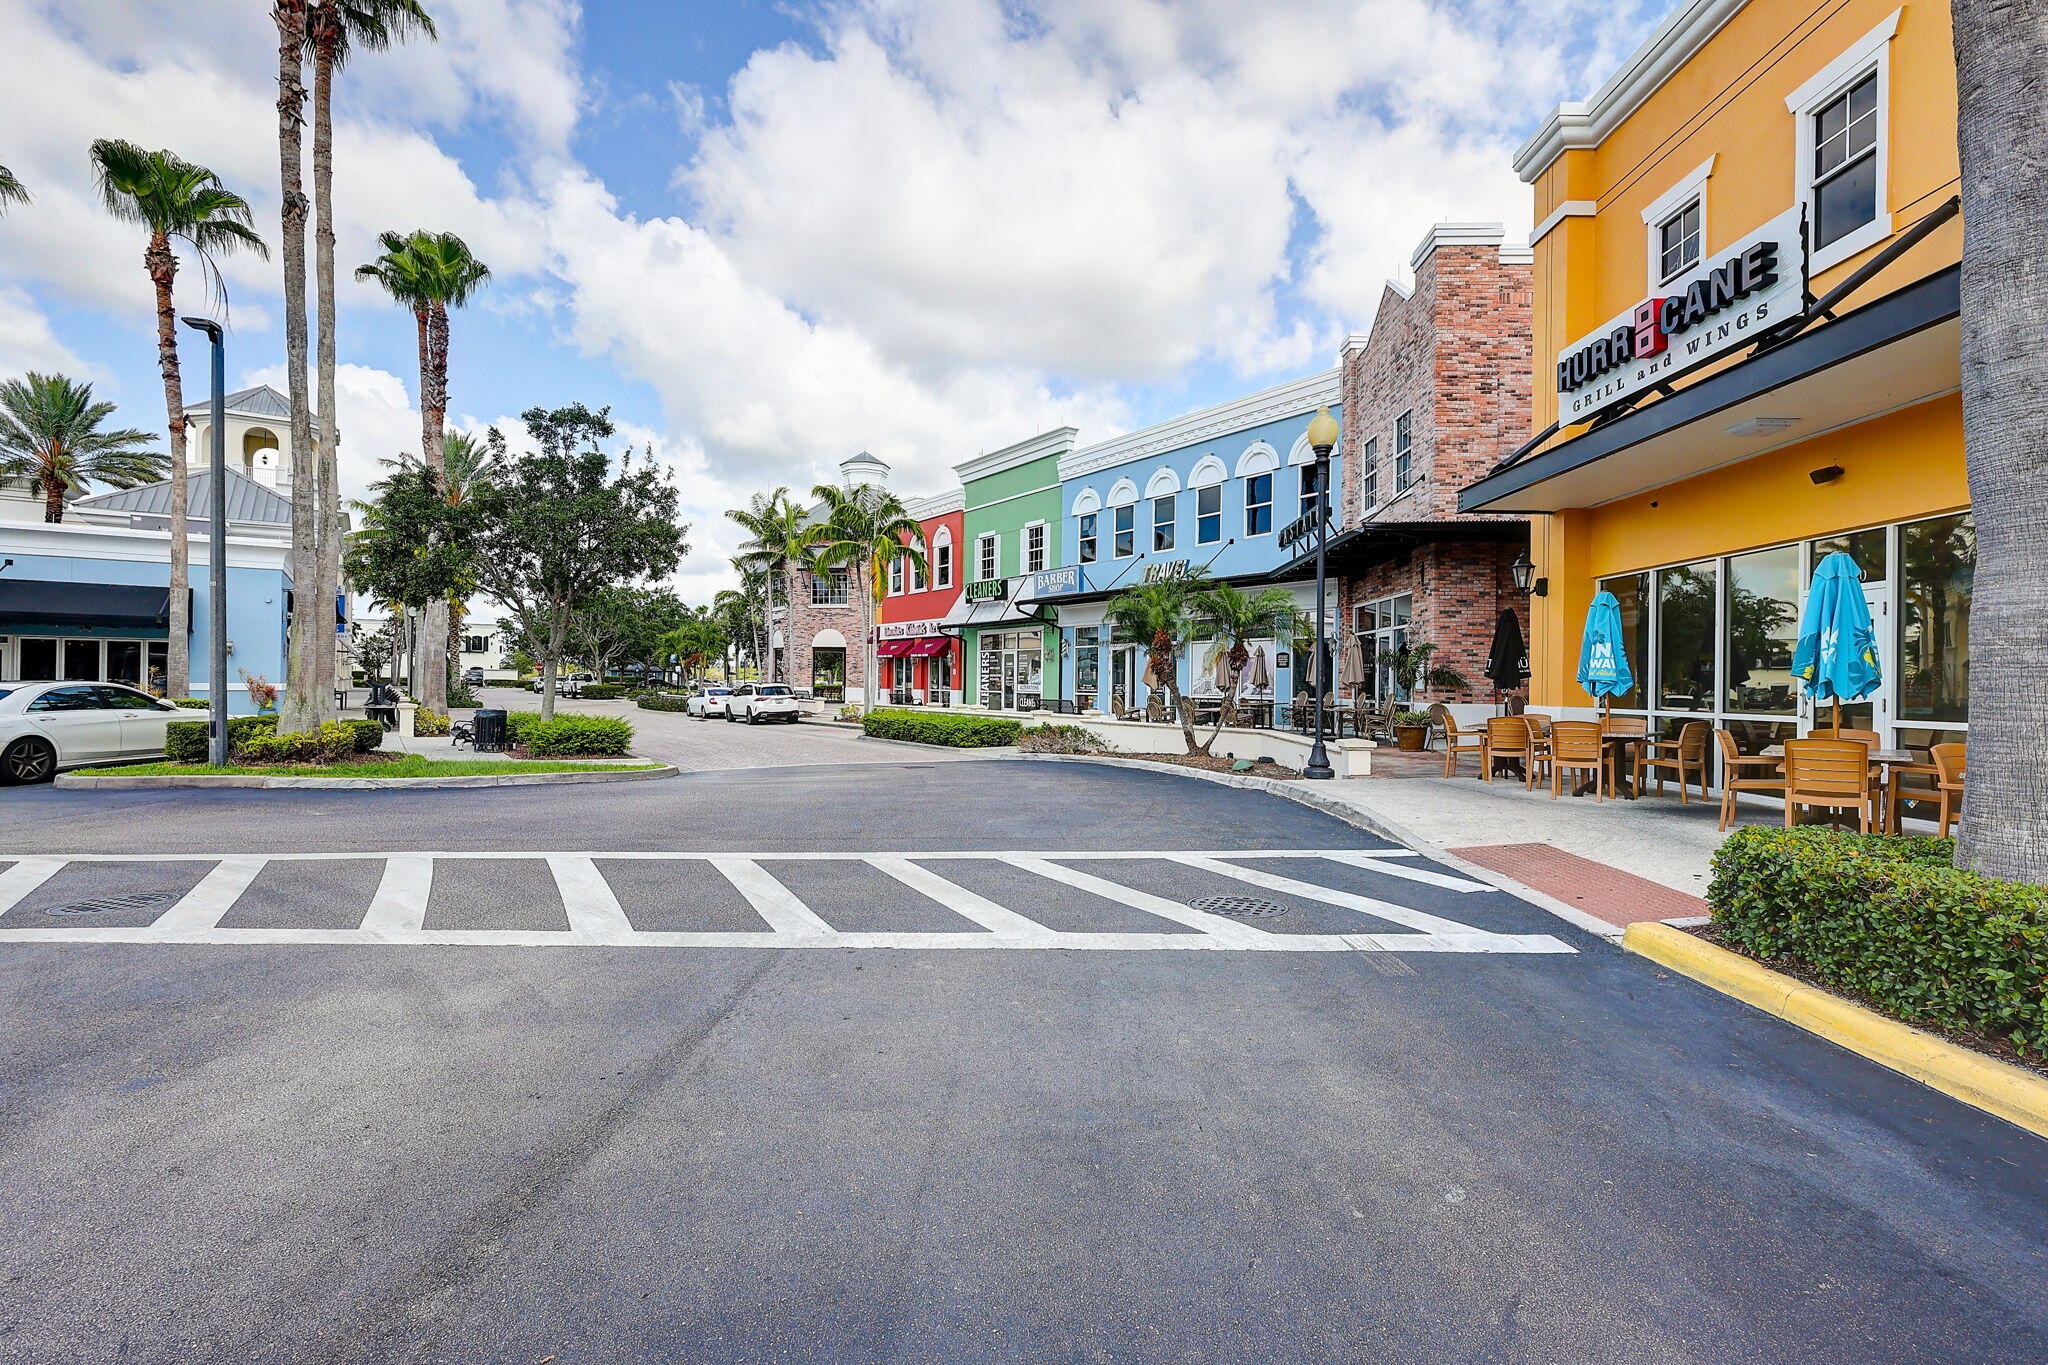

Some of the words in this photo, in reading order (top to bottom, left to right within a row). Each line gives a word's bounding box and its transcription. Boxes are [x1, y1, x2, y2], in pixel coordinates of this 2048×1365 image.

[1572, 379, 1625, 413] GRILL
[1637, 353, 1672, 381] and
[1686, 302, 1768, 356] WINGS
[965, 580, 1002, 599] CLEANERS
[1037, 571, 1076, 590] BARBER
[1048, 583, 1064, 593] SHOP
